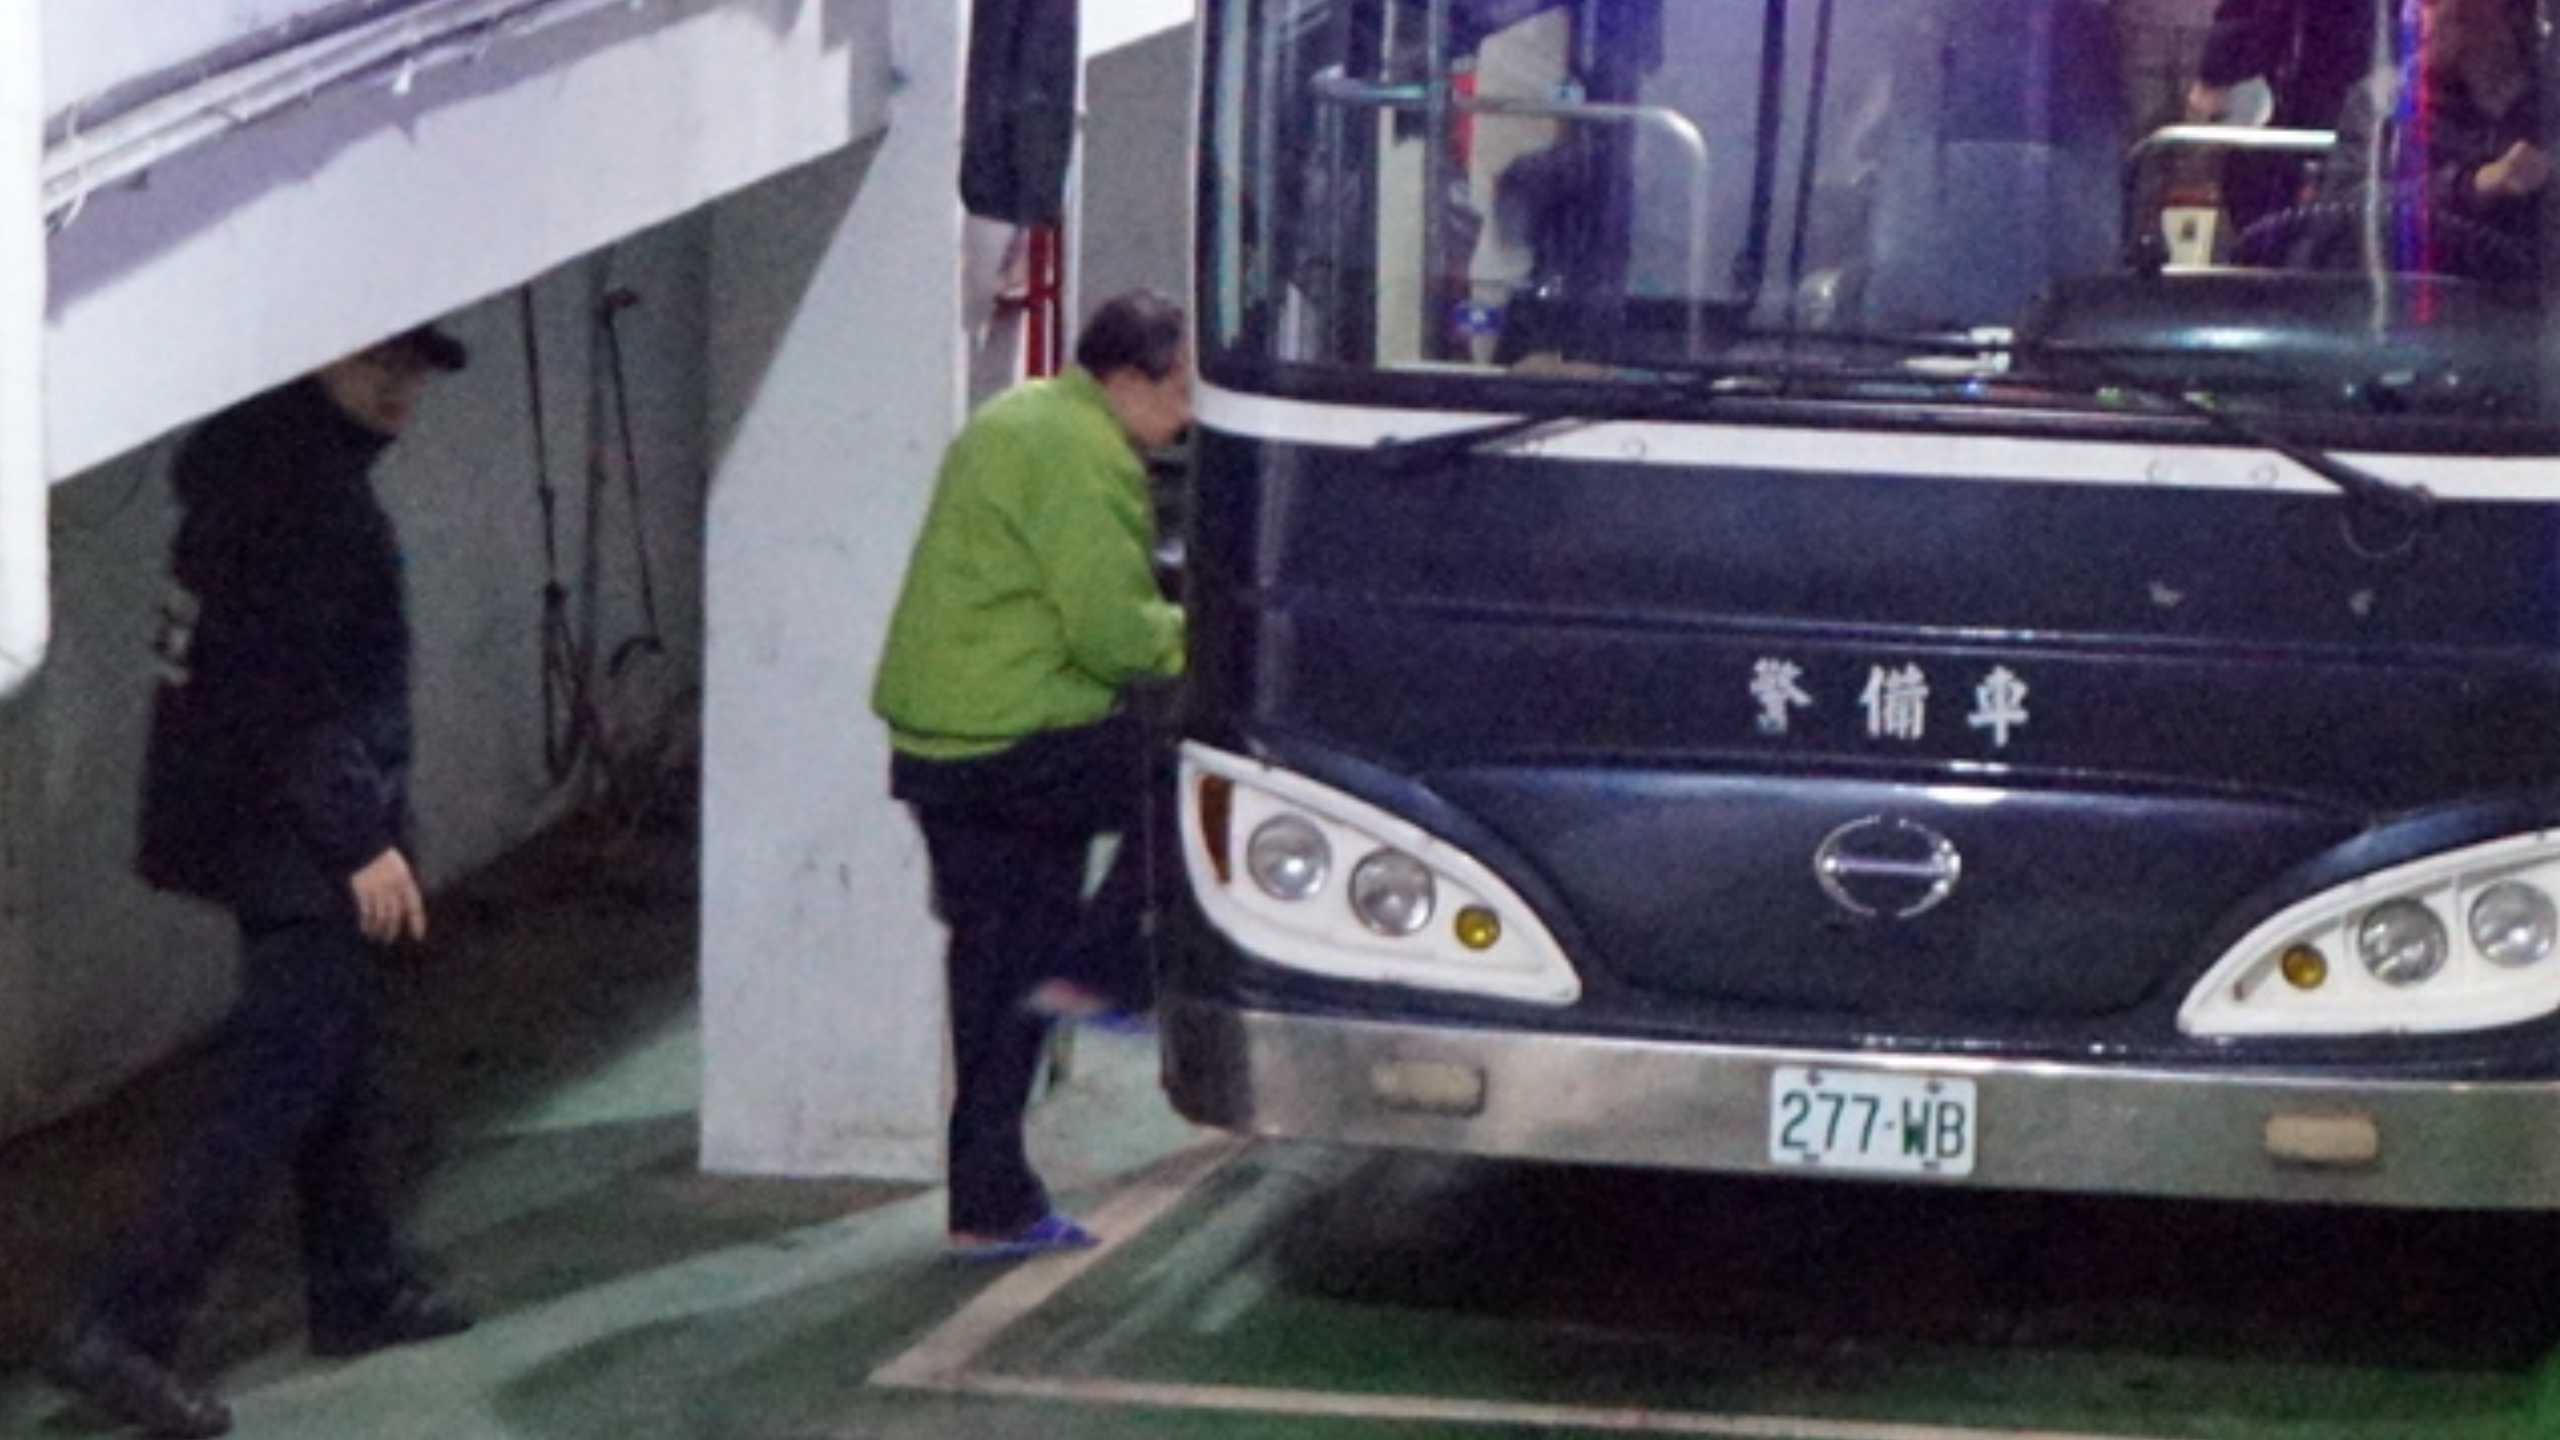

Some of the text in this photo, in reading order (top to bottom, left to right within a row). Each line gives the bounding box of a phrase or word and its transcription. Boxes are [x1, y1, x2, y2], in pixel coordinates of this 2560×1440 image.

[1750, 657, 2029, 747] 警備車
[1781, 1090, 1966, 1158] 277-WB
